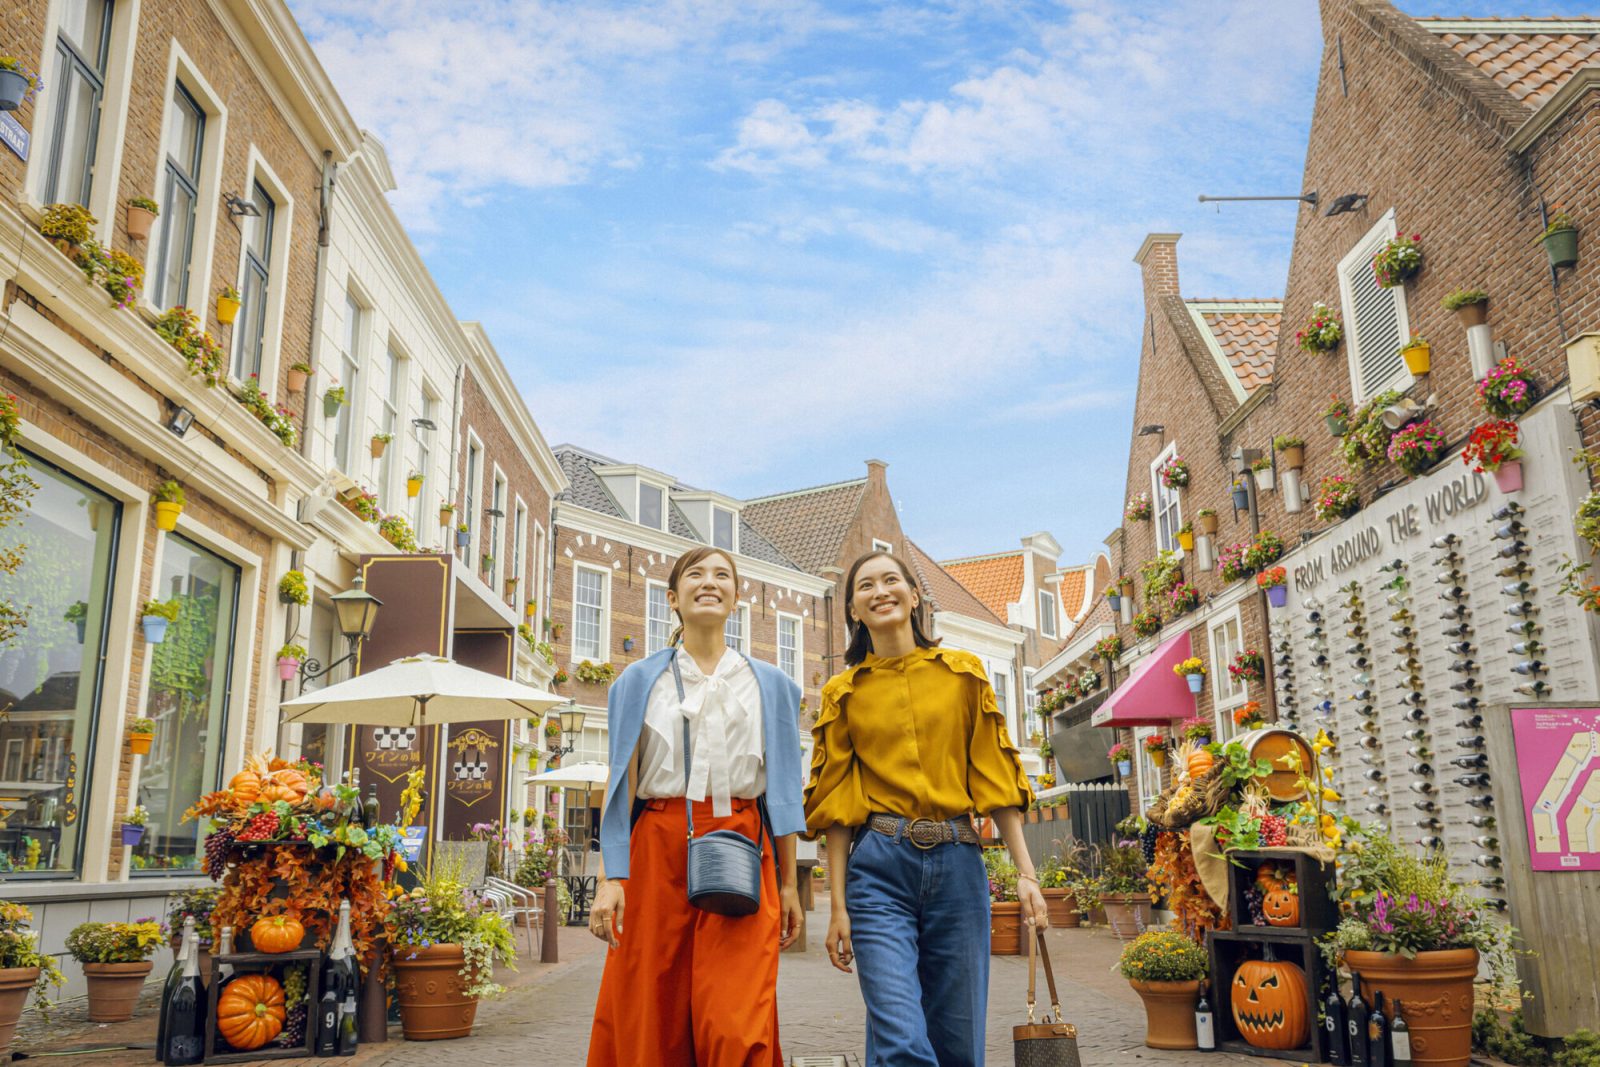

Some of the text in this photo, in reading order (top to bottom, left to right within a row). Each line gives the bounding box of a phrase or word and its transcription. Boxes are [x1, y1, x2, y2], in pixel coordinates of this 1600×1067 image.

[0, 121, 25, 153] STRAAT
[1294, 470, 1487, 593] FROM AROUND THE WORLD
[447, 780, 493, 791] ワインの城
[325, 1011, 335, 1029] 9
[1325, 1015, 1336, 1032] 6
[1348, 1019, 1358, 1036] 6
